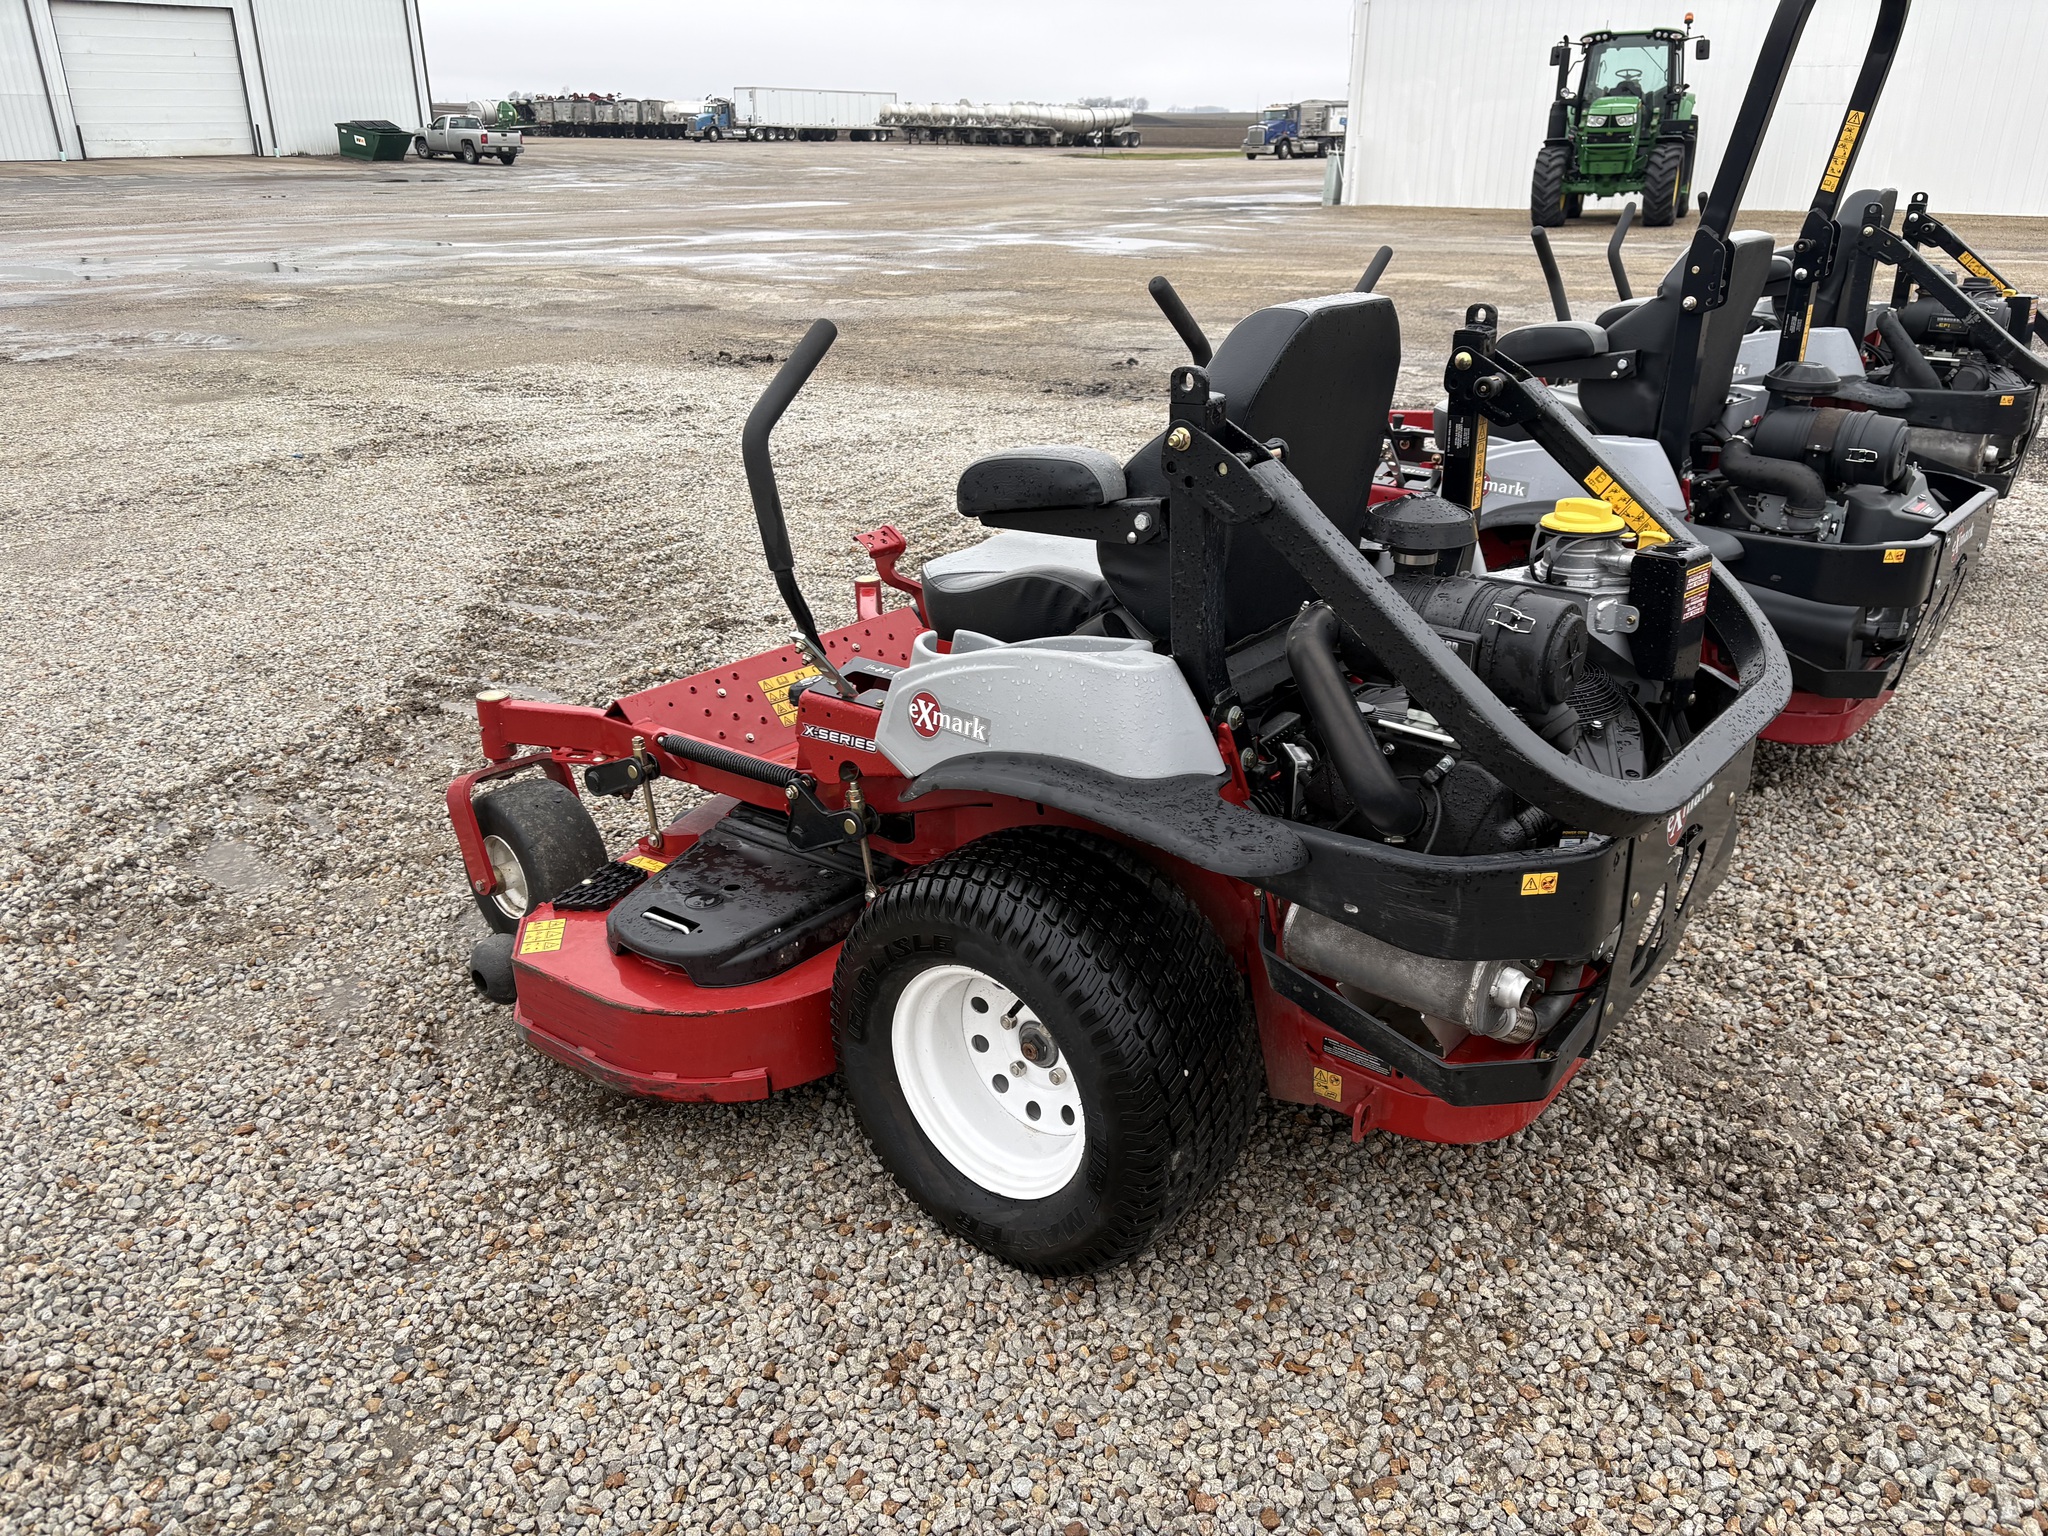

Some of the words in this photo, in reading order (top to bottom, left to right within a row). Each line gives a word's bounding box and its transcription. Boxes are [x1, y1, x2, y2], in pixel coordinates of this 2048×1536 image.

[1483, 478, 1525, 497] mark
[802, 723, 878, 752] X-SERIES
[909, 698, 987, 743] eXmark
[847, 933, 954, 1040] CARLISLE
